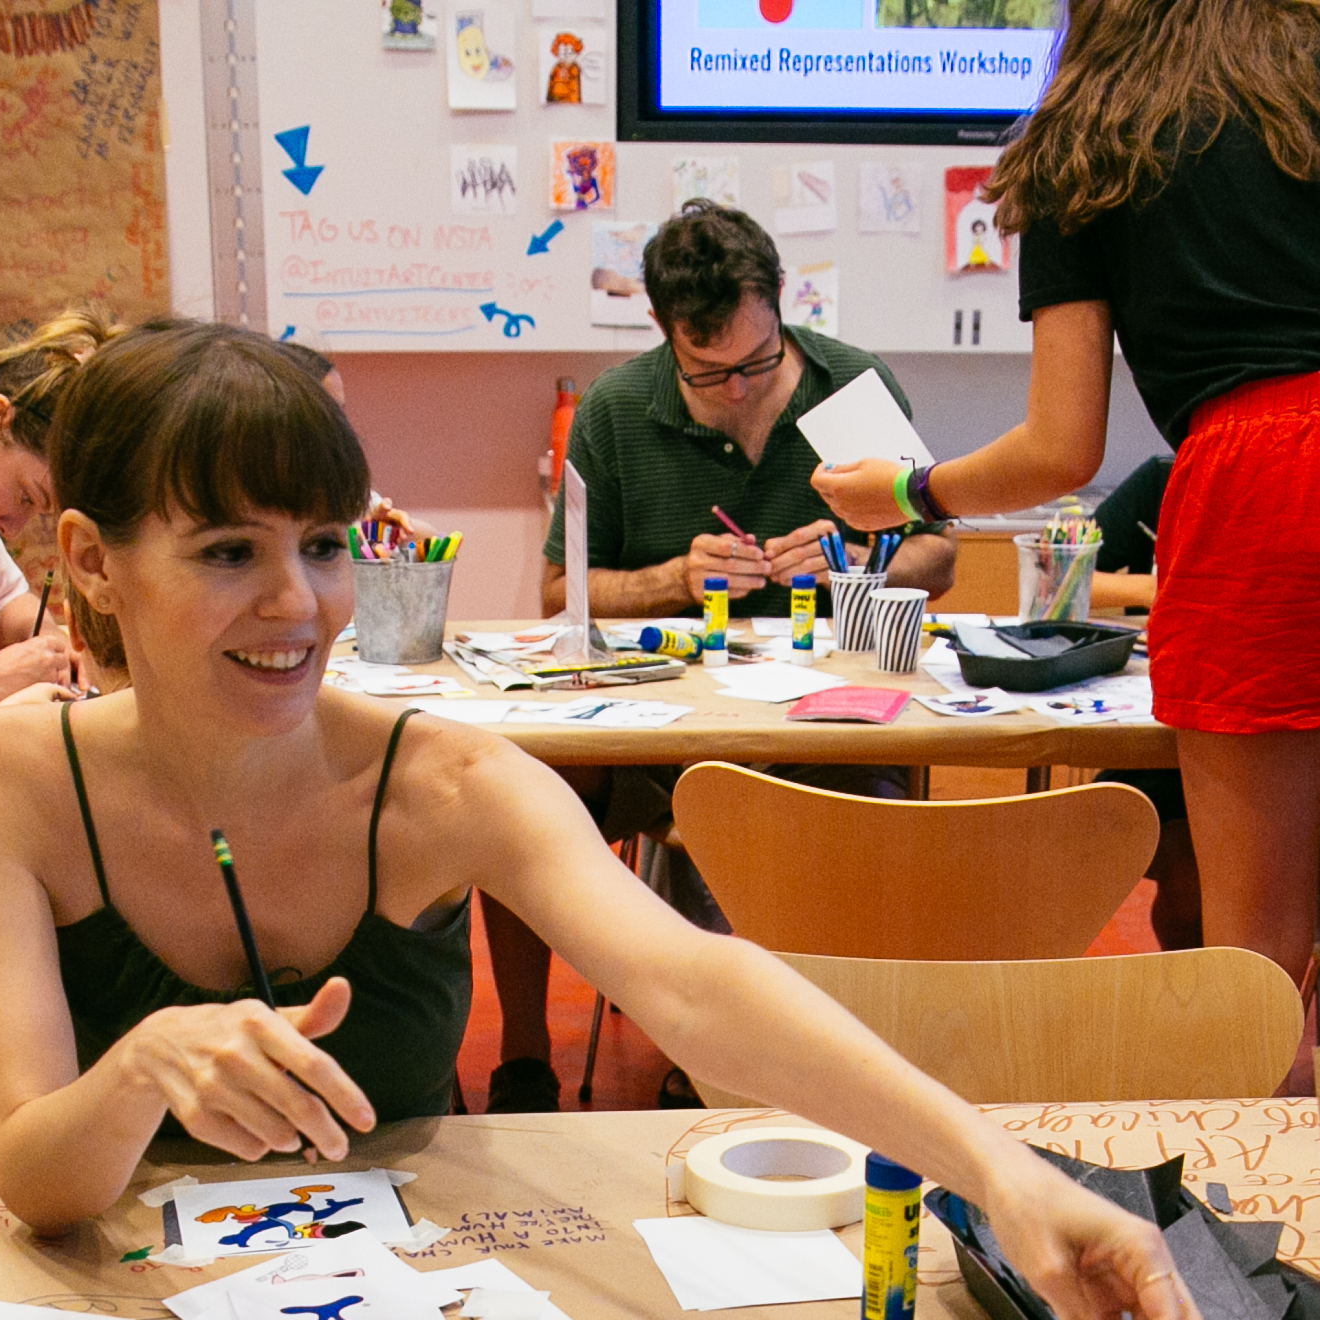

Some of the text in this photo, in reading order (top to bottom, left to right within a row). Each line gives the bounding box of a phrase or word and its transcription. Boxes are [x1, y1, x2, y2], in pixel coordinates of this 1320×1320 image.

[689, 47, 1033, 79] Remixed Representations Workshop
[279, 210, 339, 246] TAG
[347, 219, 379, 244] US
[386, 224, 421, 250] ON
[1003, 1103, 1240, 1133] Chicago
[393, 1248, 452, 1259] CHA
